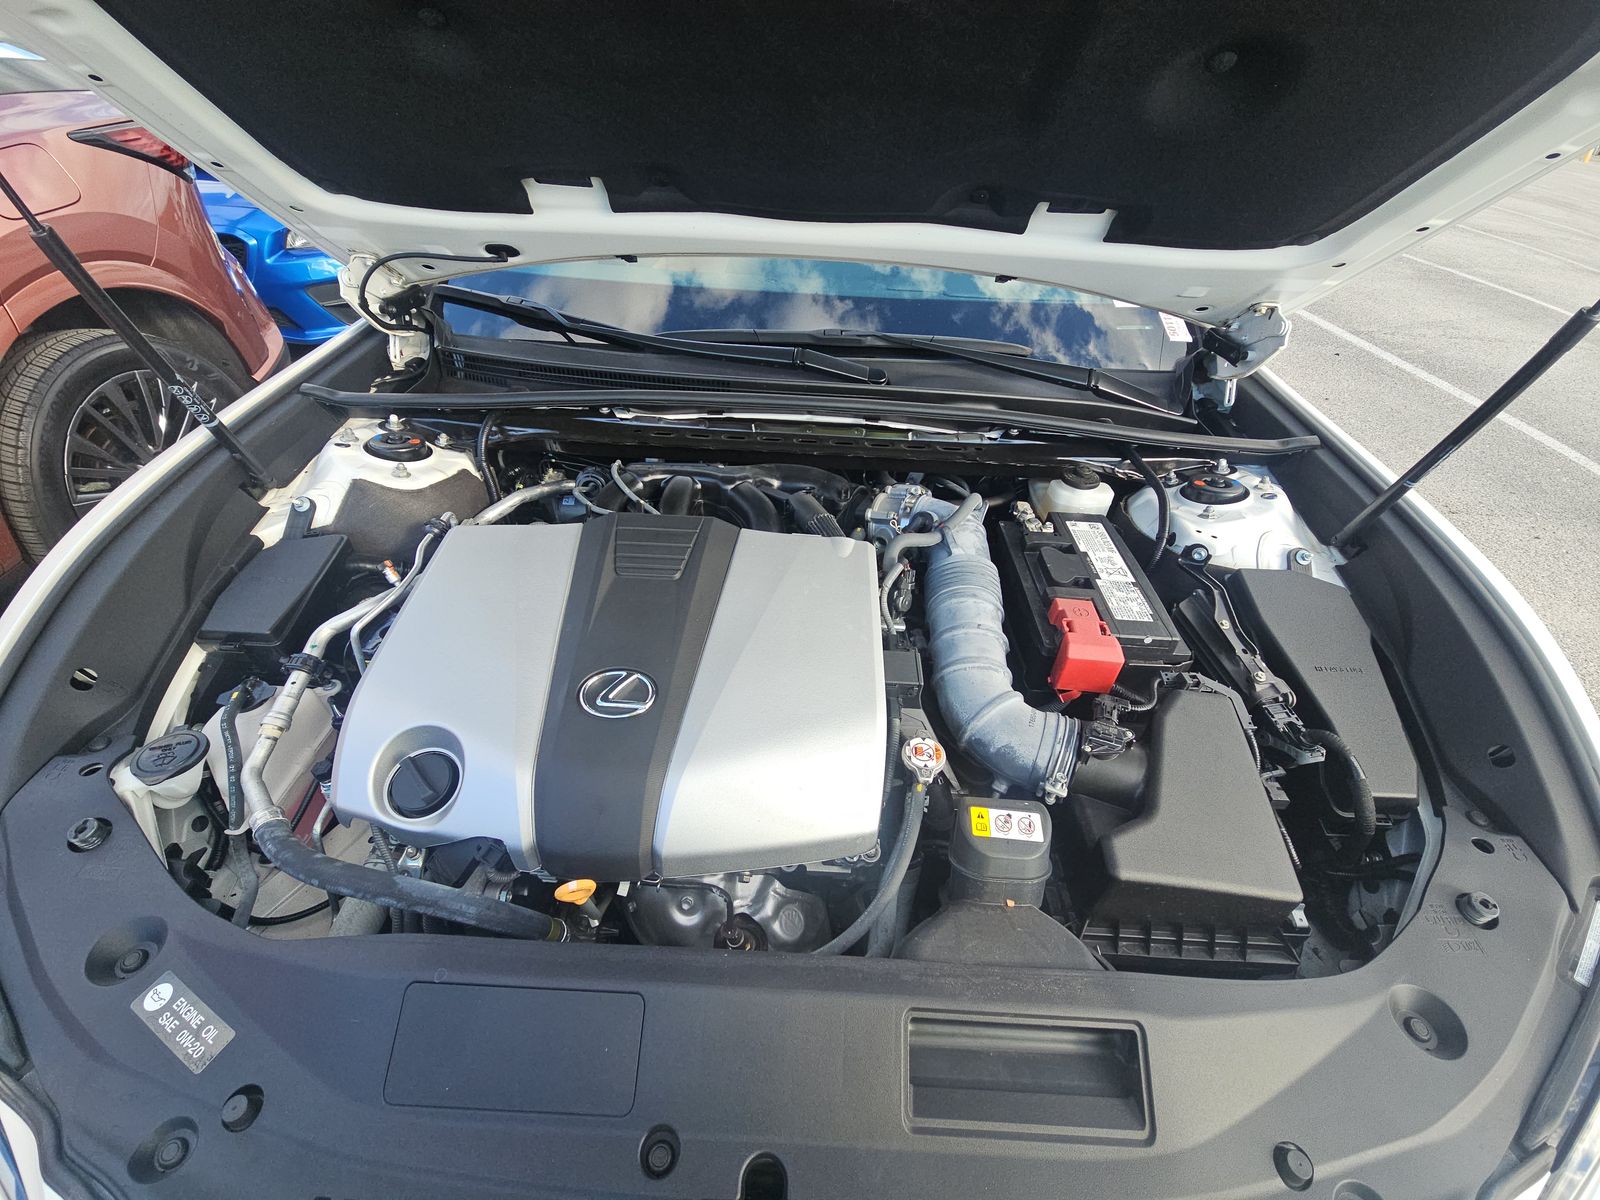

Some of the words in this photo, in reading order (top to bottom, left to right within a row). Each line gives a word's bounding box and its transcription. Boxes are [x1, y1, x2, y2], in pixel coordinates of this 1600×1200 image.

[158, 1012, 180, 1034] SAE
[175, 1029, 205, 1058] 0W-20
[172, 997, 205, 1029] ENGINE
[201, 1025, 218, 1045] OIL
